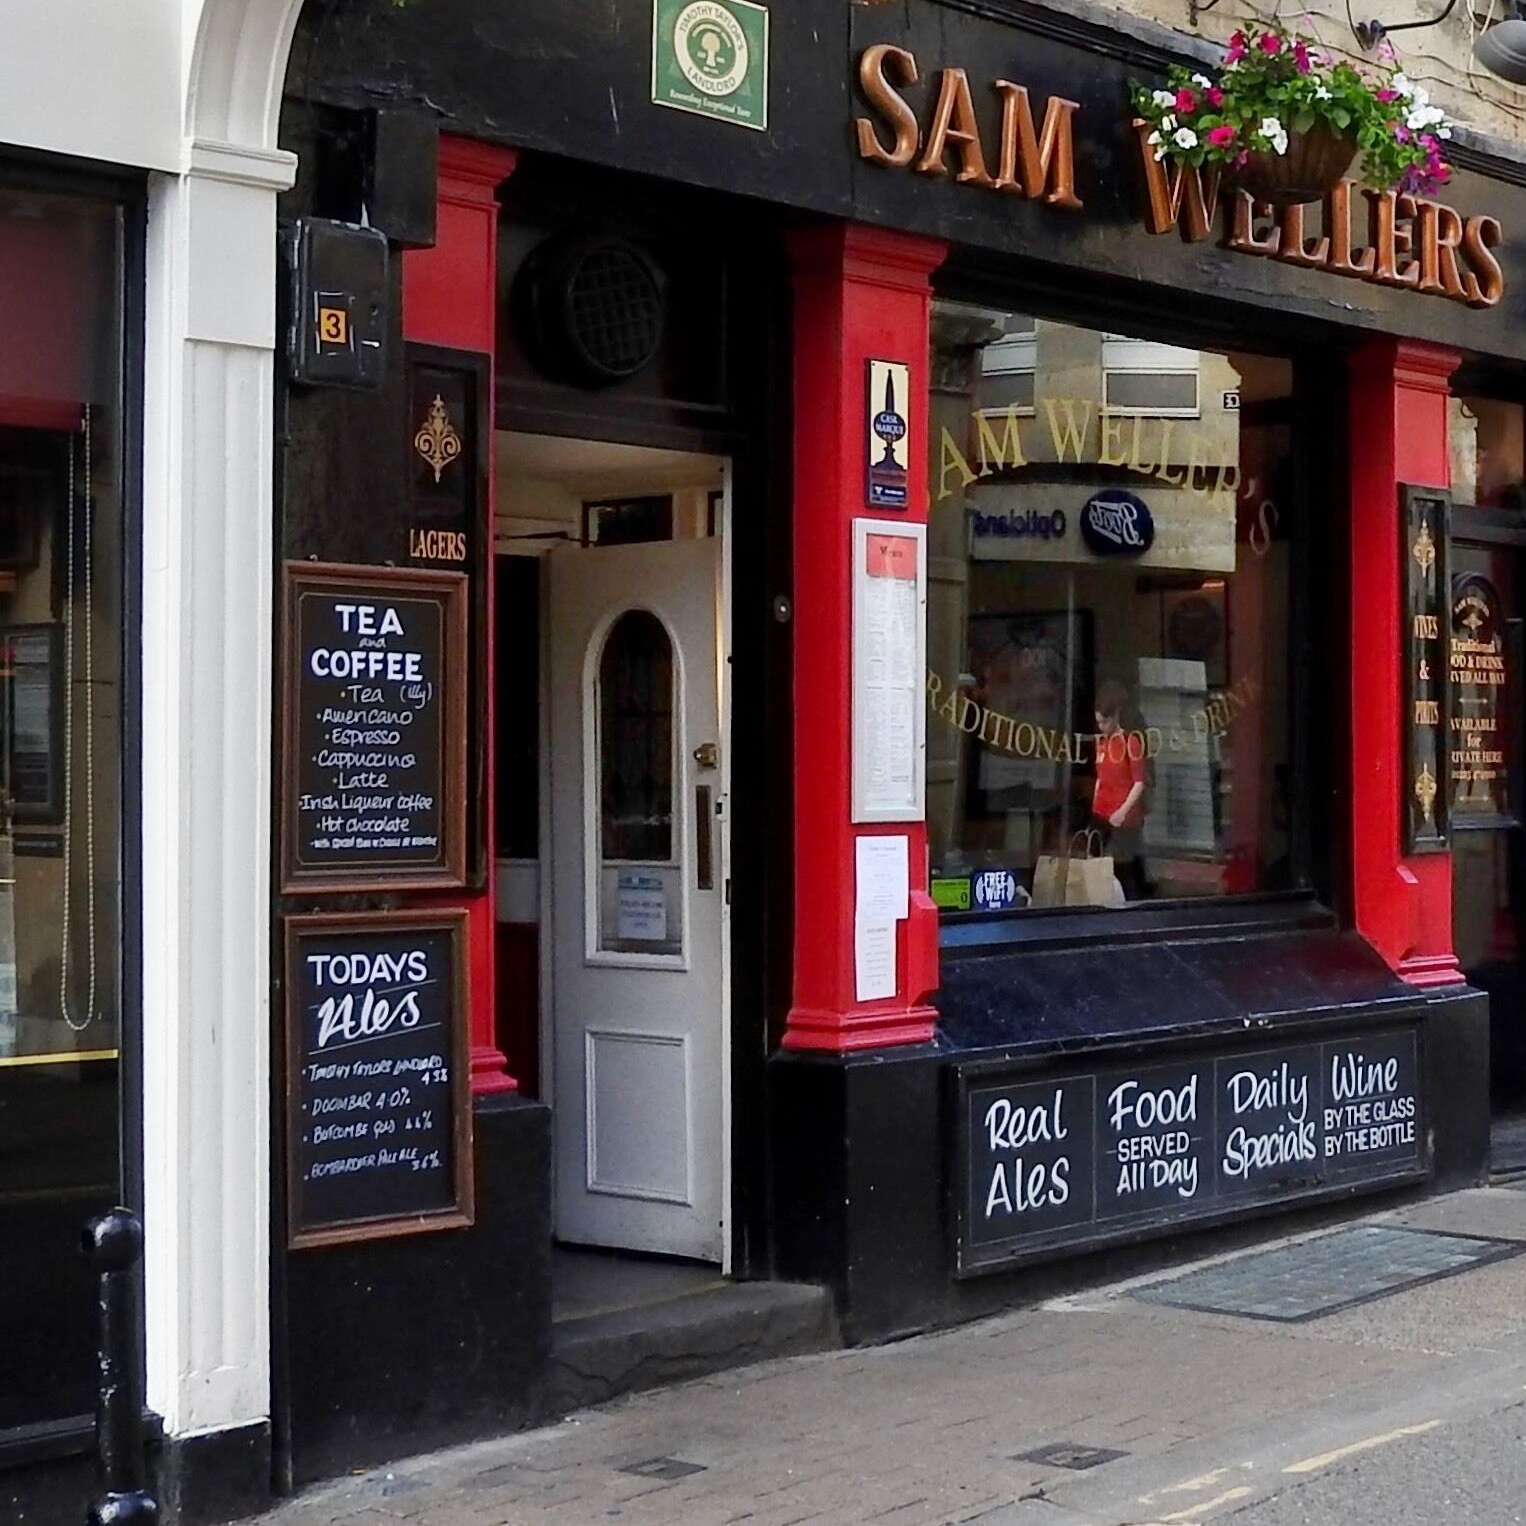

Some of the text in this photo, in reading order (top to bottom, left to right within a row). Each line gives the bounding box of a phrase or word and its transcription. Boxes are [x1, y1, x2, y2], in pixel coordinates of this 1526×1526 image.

[688, 65, 736, 93] LANDLORD
[856, 43, 1084, 211] SAM
[325, 312, 341, 340] 3
[938, 402, 1028, 500] AM
[409, 529, 466, 561] LAGERS
[335, 604, 404, 635] TEA
[358, 637, 387, 649] and
[311, 648, 424, 682] COFFEE
[1420, 659, 1430, 680] &
[347, 685, 384, 703] Tea
[322, 708, 413, 725] Americano
[926, 668, 1088, 764] RADITIONAL
[1095, 726, 1162, 764] FOOD
[332, 728, 400, 748] Espresso
[318, 749, 416, 769] Cappuccino
[338, 772, 389, 789] Latte
[301, 794, 339, 810] Irish
[342, 794, 395, 814] Liqueur
[322, 816, 345, 832] Hot
[984, 872, 1006, 888] FREE
[307, 950, 427, 986] TODAYS
[317, 988, 420, 1048] Ales
[1227, 1062, 1308, 1123] Daily
[1330, 1053, 1398, 1101] Wine
[1107, 1074, 1198, 1131] Food
[1324, 1097, 1415, 1131] BY THE GLASS
[983, 1089, 1068, 1151] Real
[1117, 1131, 1190, 1164] SERVED
[1222, 1122, 1316, 1178] Specials
[1324, 1122, 1415, 1157] BY THE BOTTLE
[985, 1158, 1070, 1219] Ales
[1117, 1156, 1198, 1198] All Day
